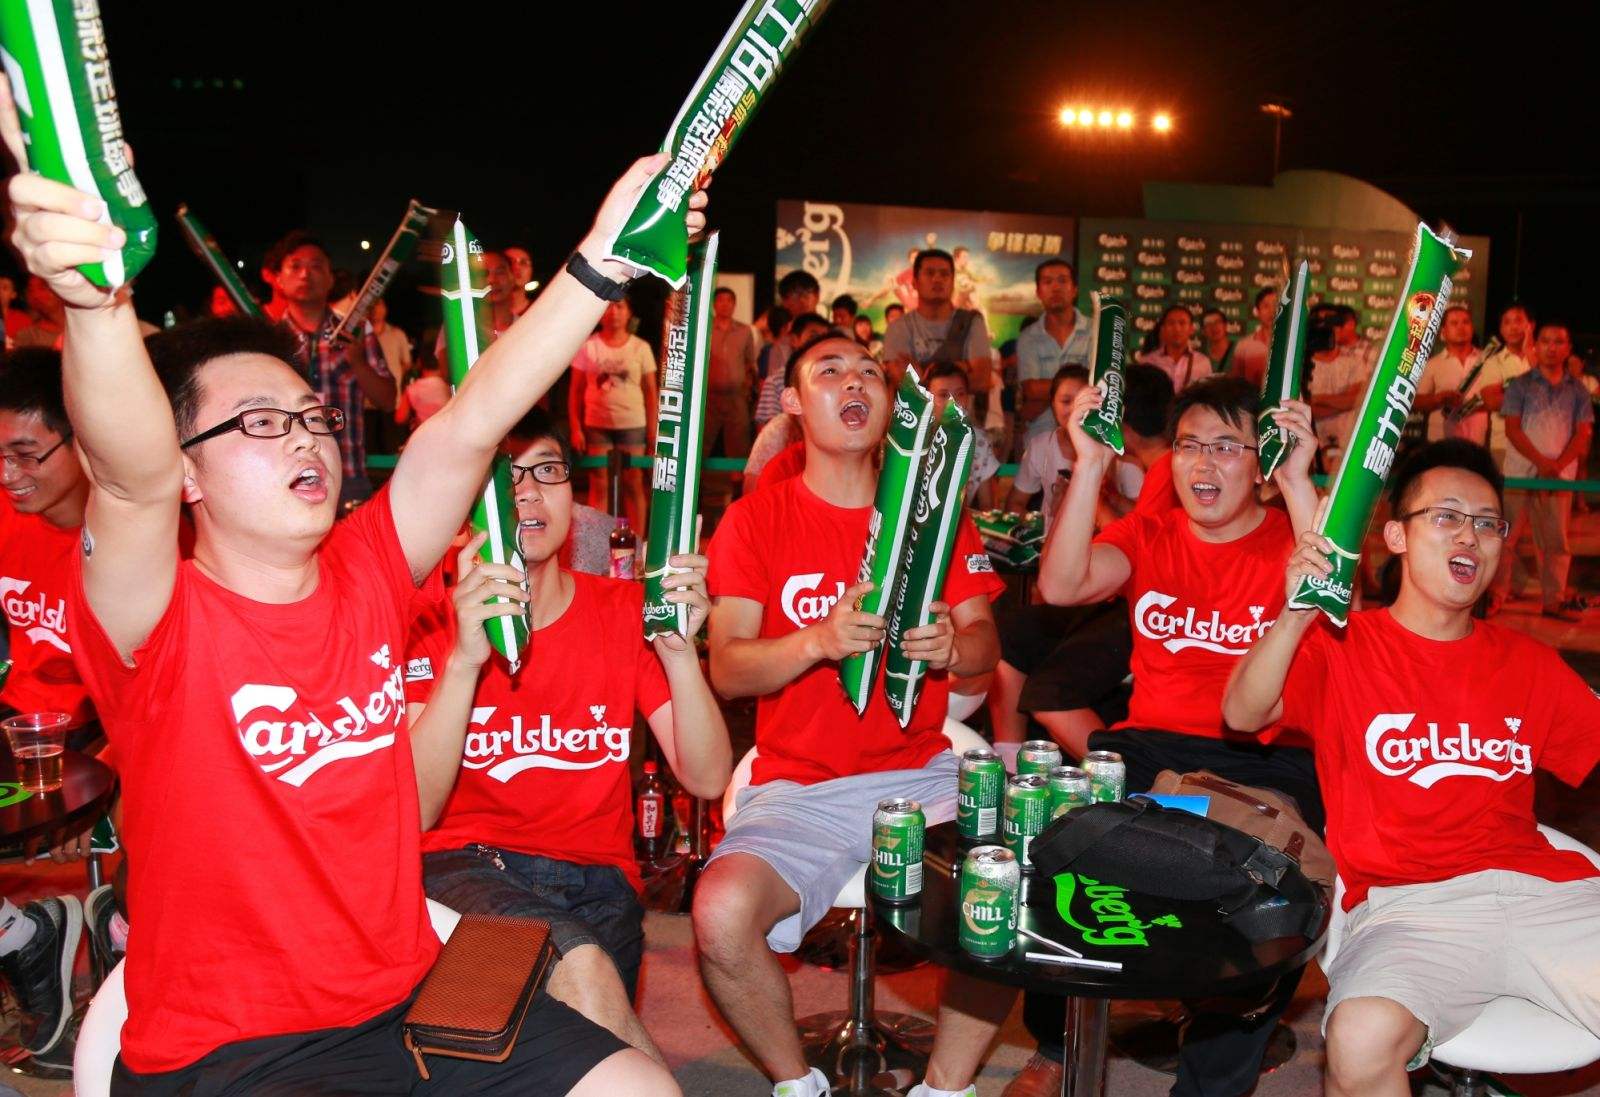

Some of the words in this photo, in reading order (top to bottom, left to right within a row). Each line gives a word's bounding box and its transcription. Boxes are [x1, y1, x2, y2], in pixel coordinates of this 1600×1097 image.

[730, 0, 815, 92] 士伯
[0, 576, 72, 654] Carlsb
[1306, 574, 1353, 605] Carlsber
[1365, 713, 1533, 790] Carlsberg
[962, 901, 1005, 922] CHILL
